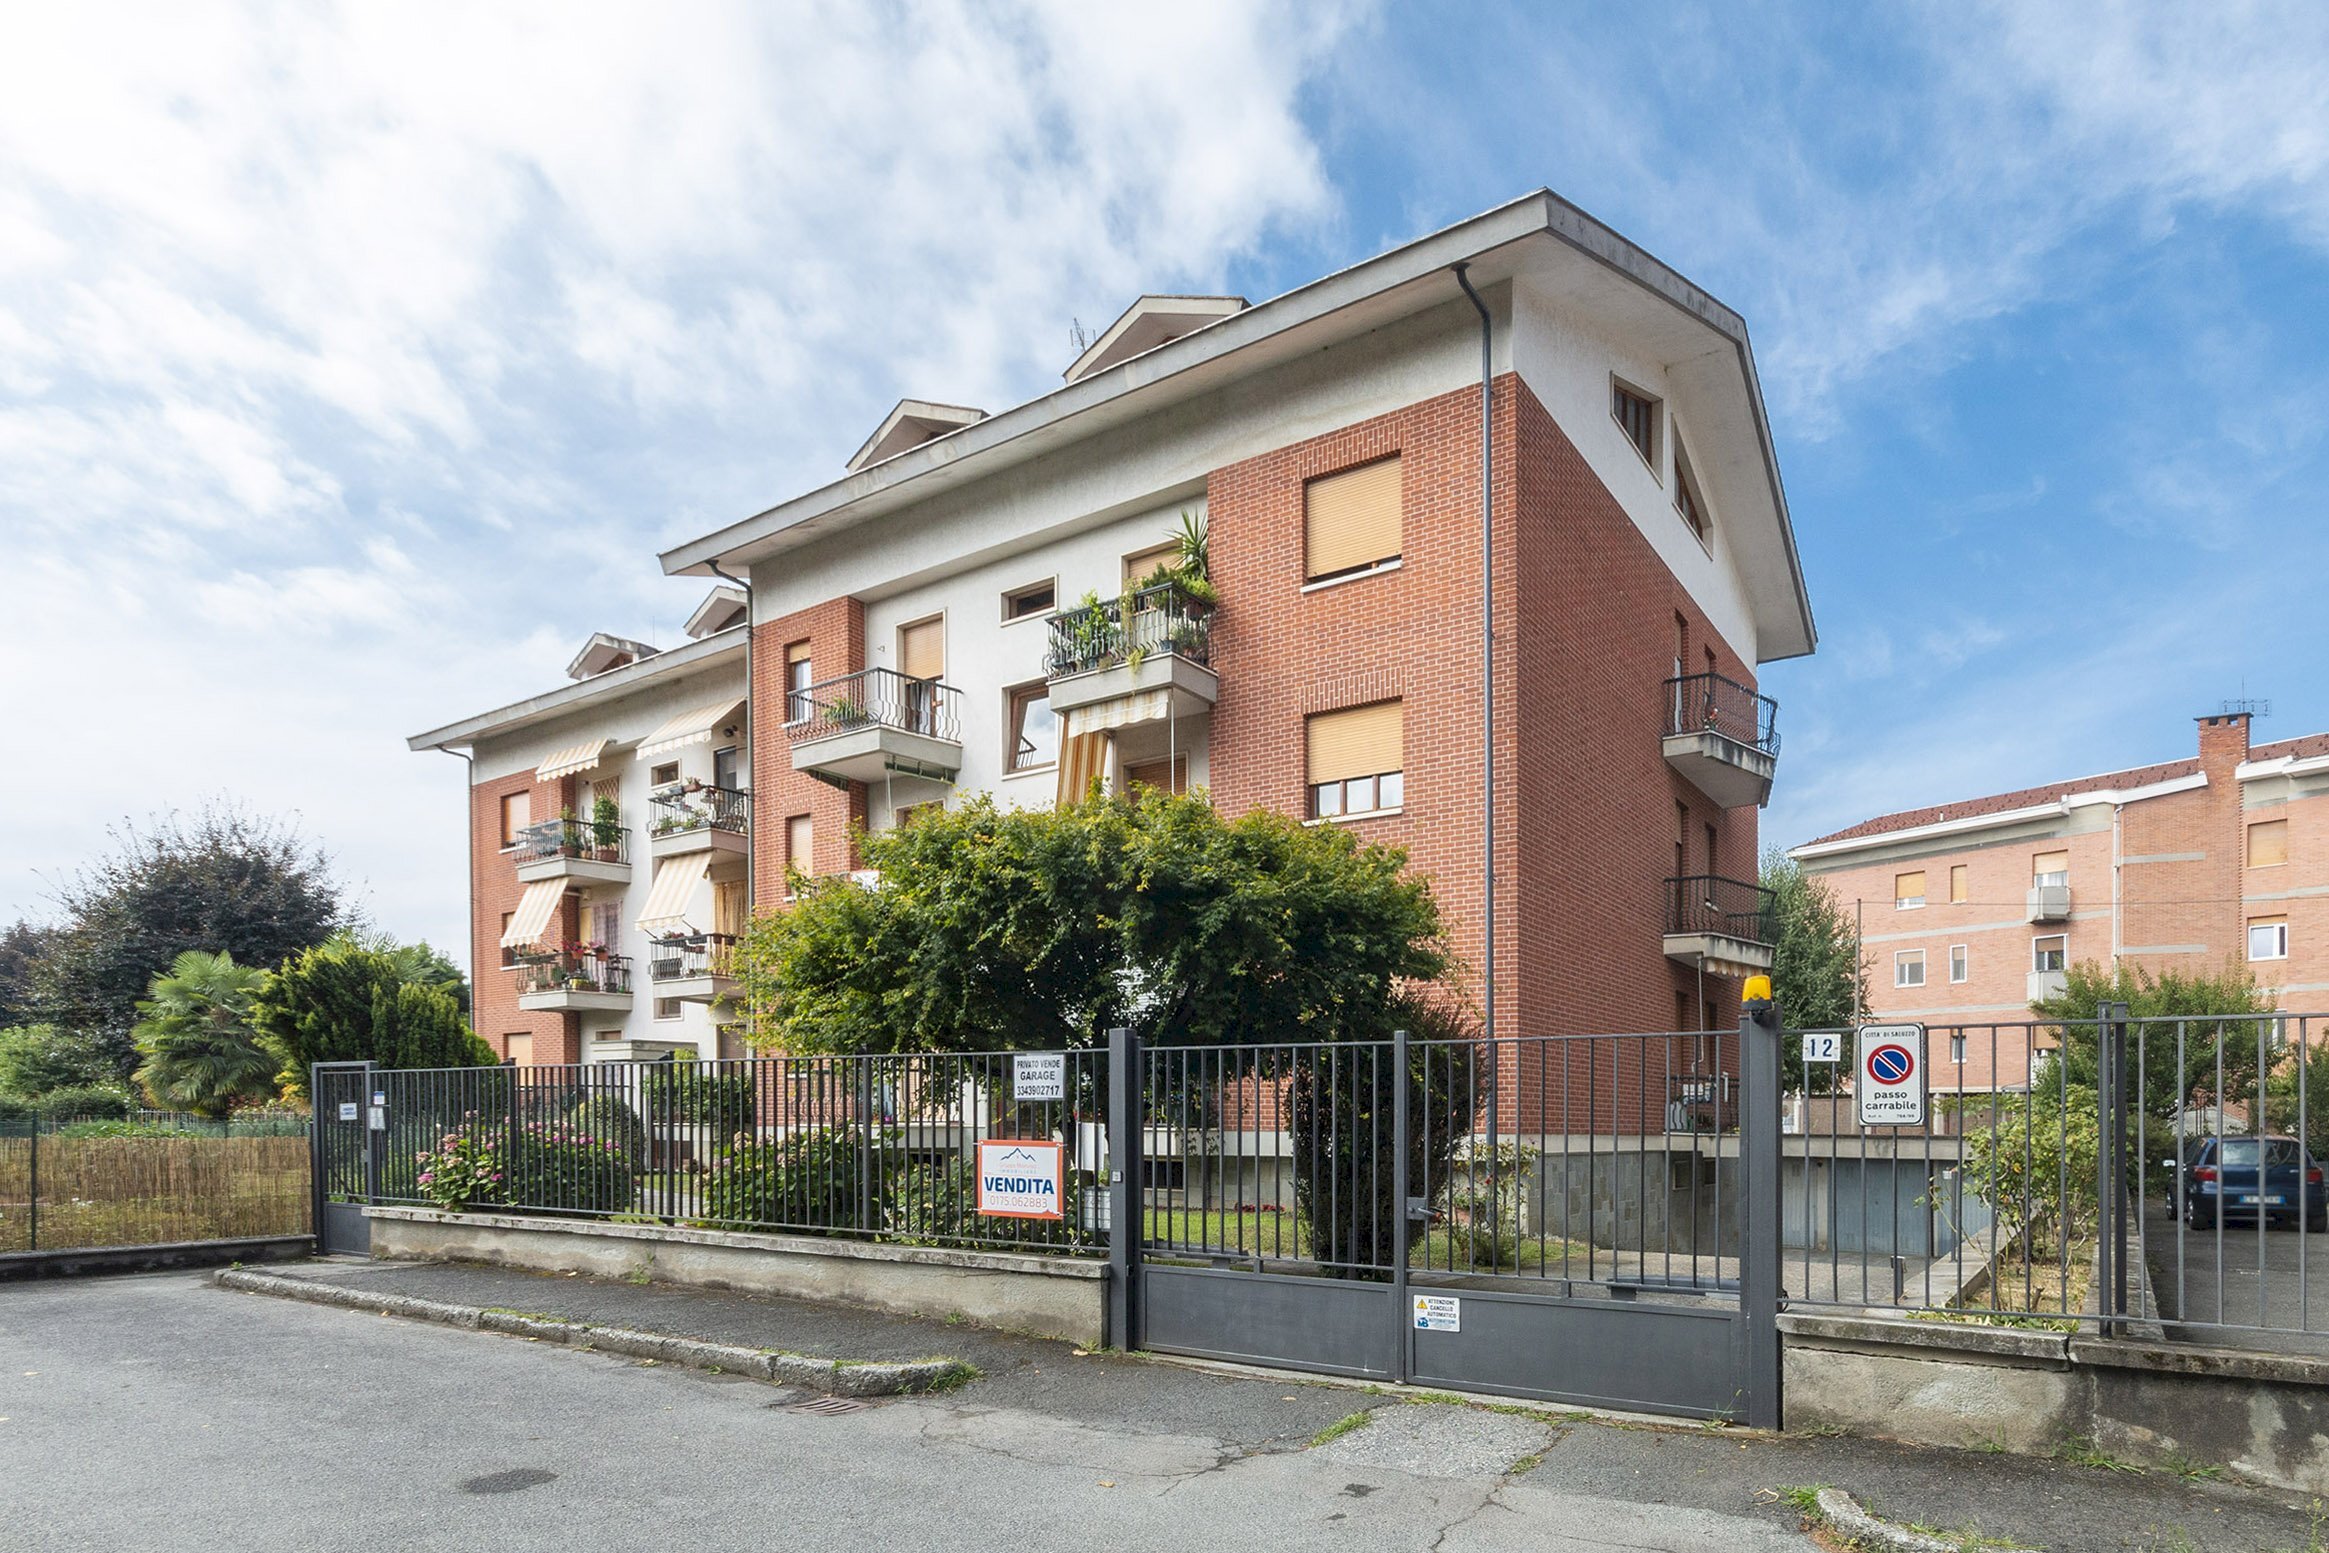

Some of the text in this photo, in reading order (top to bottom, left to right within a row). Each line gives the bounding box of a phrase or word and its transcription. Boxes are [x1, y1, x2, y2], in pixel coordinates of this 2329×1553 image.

[1810, 1039, 1833, 1057] 12
[1017, 1059, 1060, 1069] PRIVATO VENDE
[1020, 1071, 1055, 1081] GARAGE
[1017, 1085, 1060, 1096] 3343902717
[1874, 1091, 1907, 1100] passo
[1865, 1101, 1917, 1110] carrabile
[984, 1176, 1054, 1194] VENDITA
[990, 1195, 1048, 1208] 0175.062883
